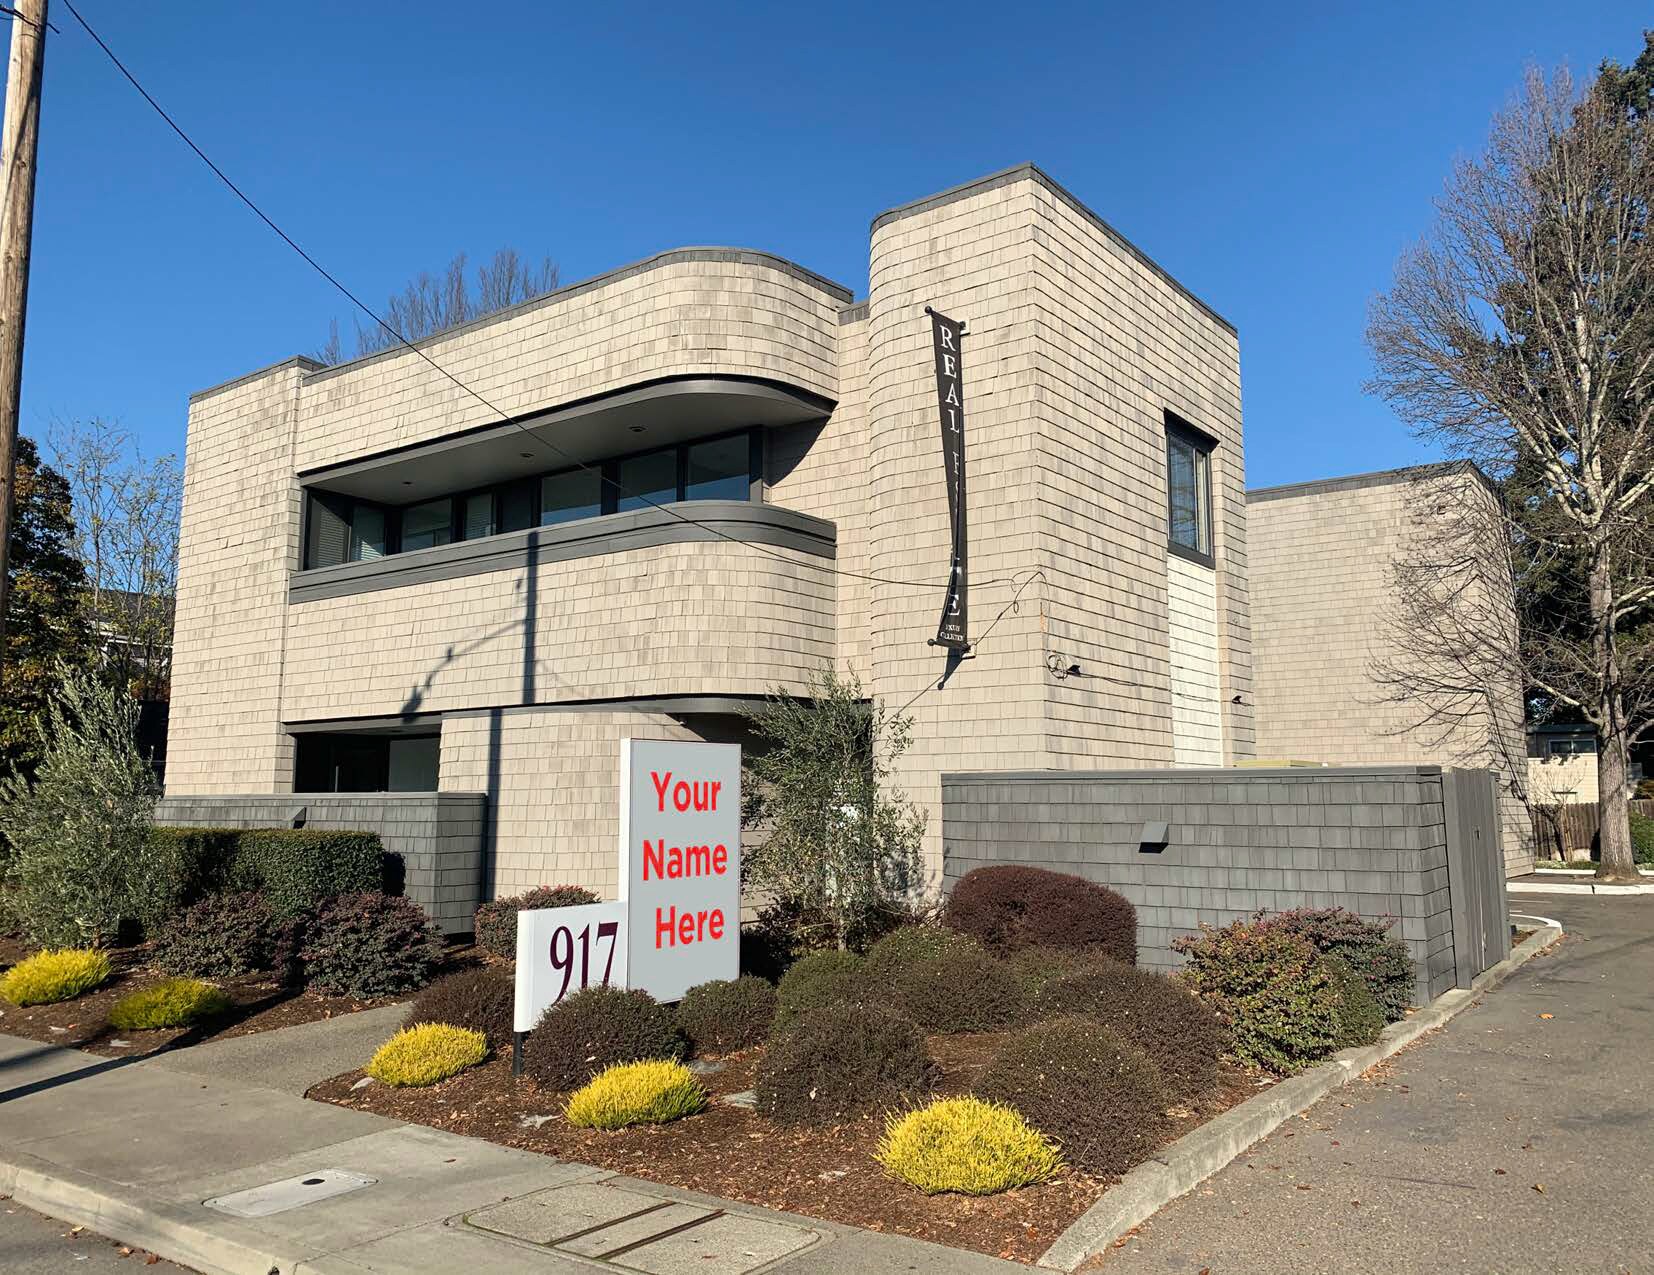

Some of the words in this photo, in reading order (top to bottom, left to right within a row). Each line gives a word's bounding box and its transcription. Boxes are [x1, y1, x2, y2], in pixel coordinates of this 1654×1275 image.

[939, 324, 961, 433] REAL
[650, 770, 721, 812] Your
[642, 839, 728, 881] Name
[655, 905, 725, 949] Here
[550, 921, 618, 1007] 917
